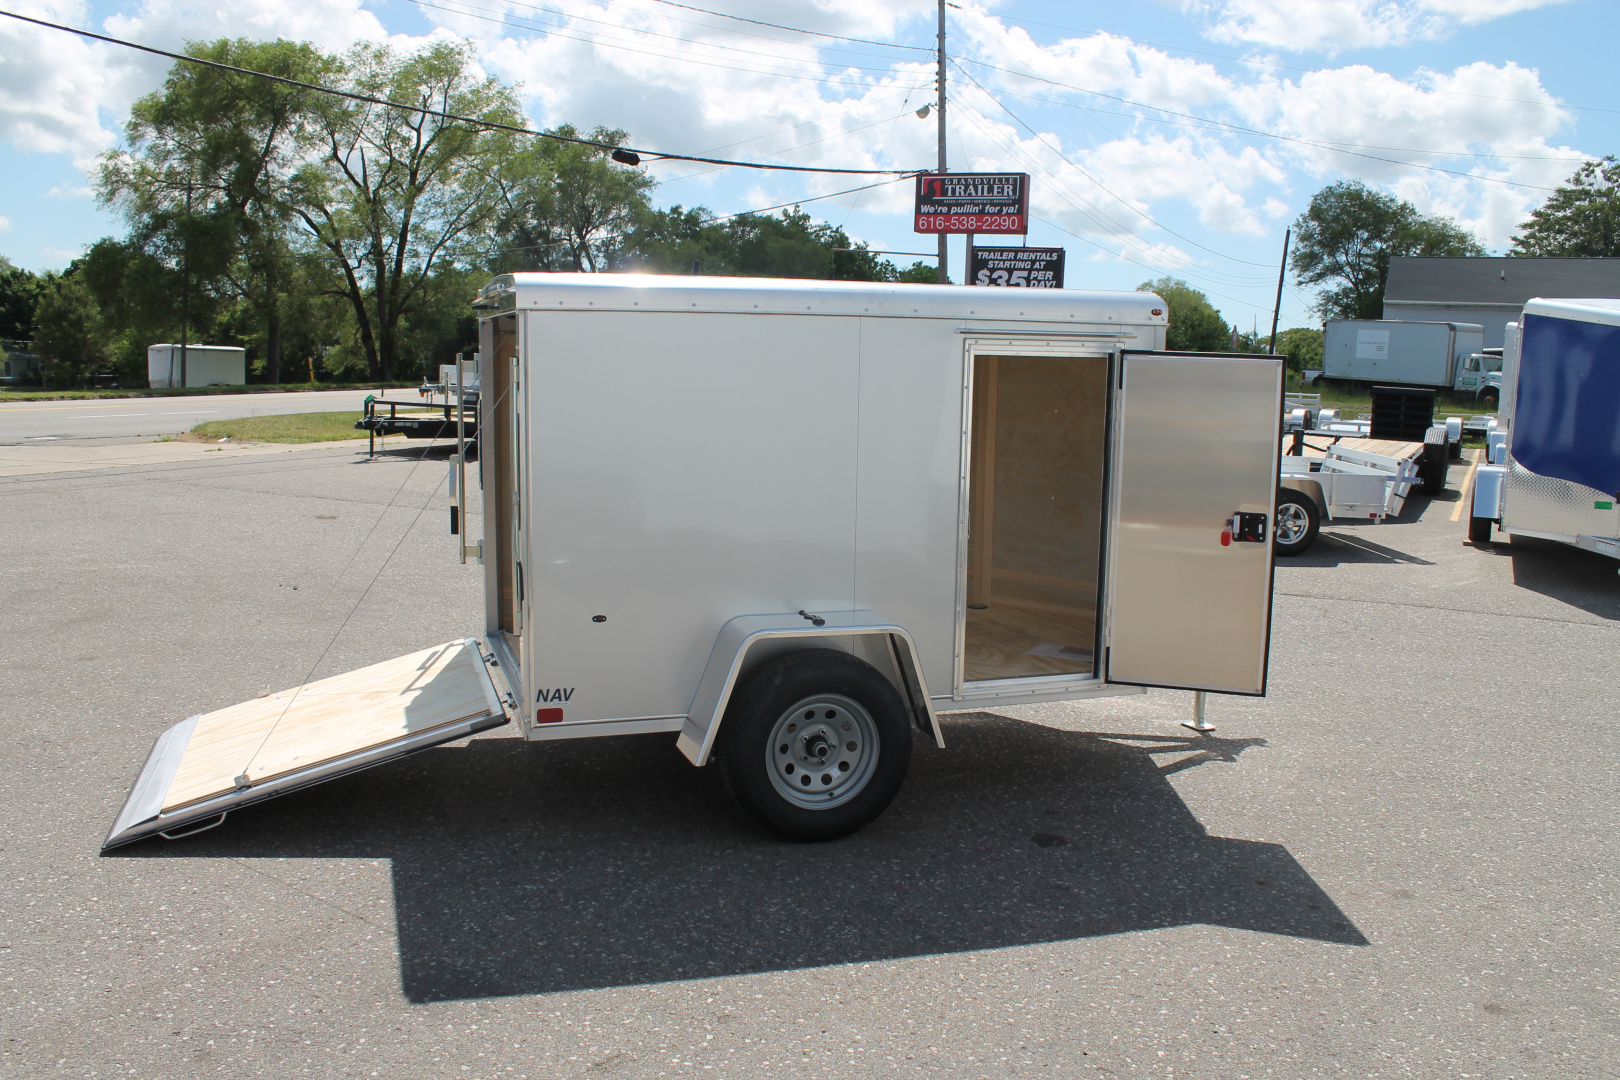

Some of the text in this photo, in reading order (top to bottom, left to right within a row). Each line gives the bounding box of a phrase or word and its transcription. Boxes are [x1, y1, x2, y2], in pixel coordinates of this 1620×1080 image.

[945, 184, 1013, 196] TRAILER
[920, 204, 1018, 214] We're pullin' for ya!
[918, 216, 1018, 230] 616-538-2290
[1016, 252, 1058, 260] RENTALS
[976, 268, 1028, 287] $35
[1030, 271, 1053, 280] PER
[536, 688, 576, 702] NAV
